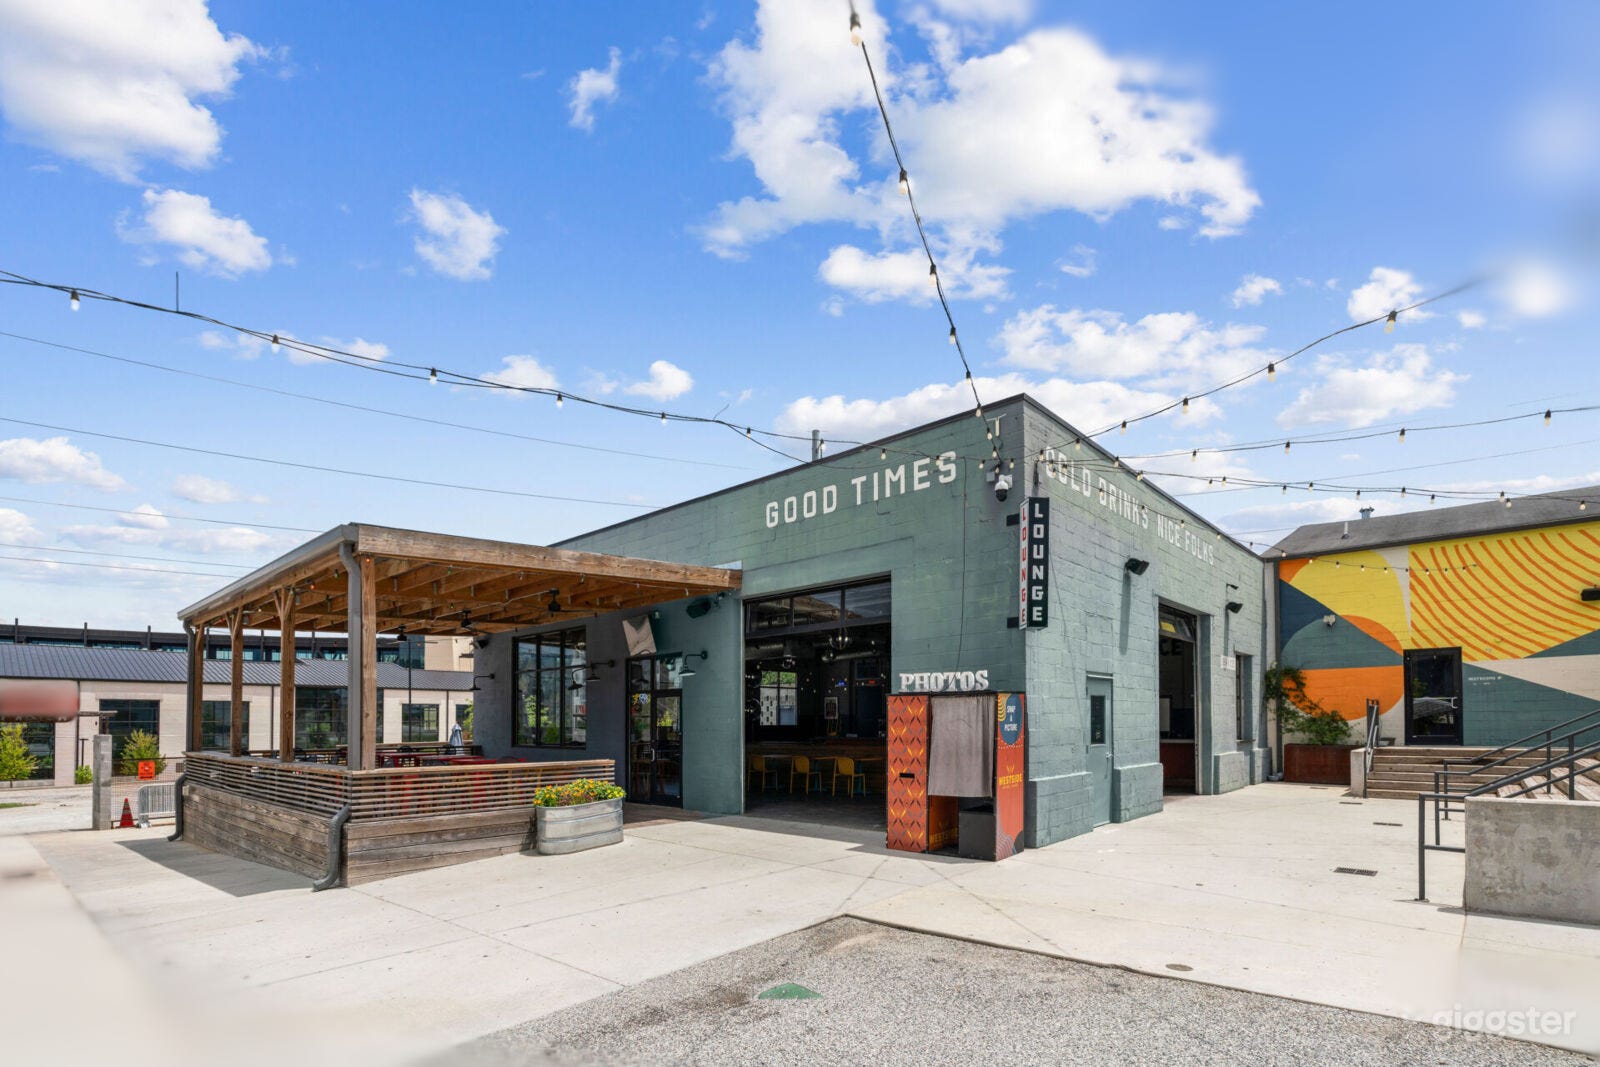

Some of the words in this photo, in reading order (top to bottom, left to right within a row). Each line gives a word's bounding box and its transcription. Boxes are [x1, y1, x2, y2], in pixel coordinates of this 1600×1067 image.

[765, 484, 838, 528] GOOD
[851, 450, 957, 506] TIMES
[1045, 446, 1092, 498] COLD
[1098, 476, 1149, 530] DRINKS
[1157, 513, 1182, 549] NICE
[1184, 529, 1214, 566] FOLKS
[1031, 503, 1044, 621] LOUNGE
[898, 669, 989, 692] PHOTOS
